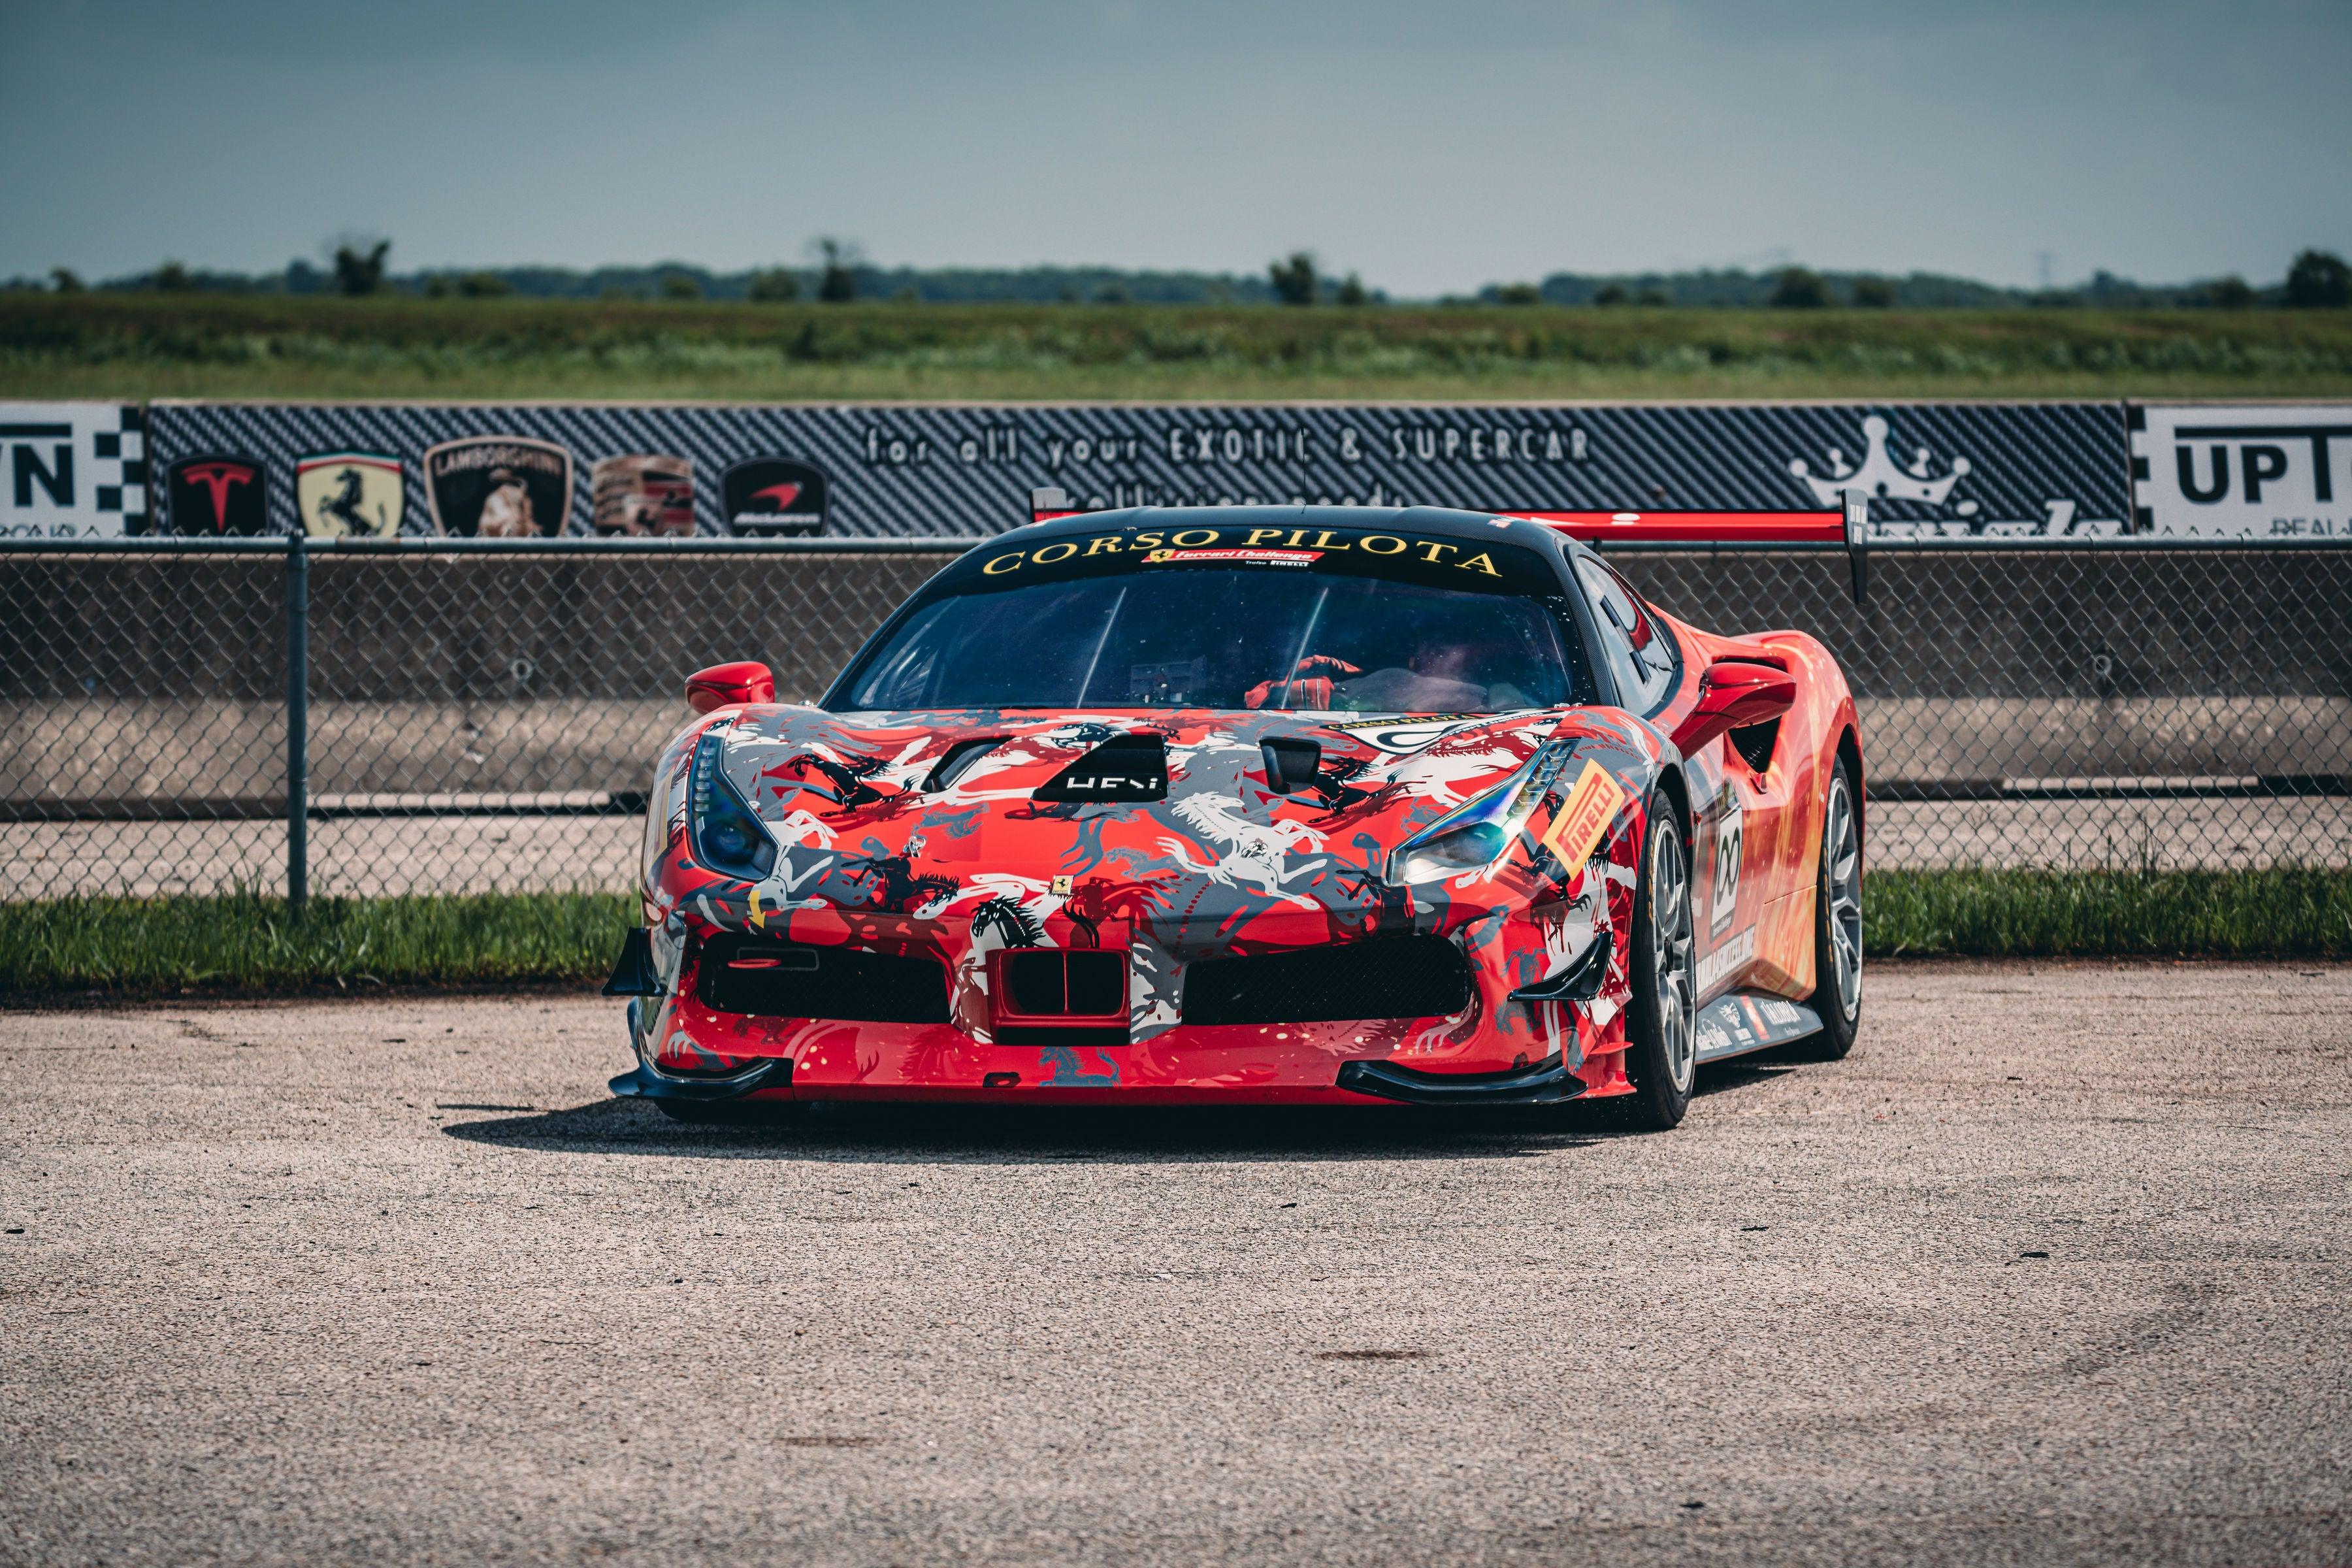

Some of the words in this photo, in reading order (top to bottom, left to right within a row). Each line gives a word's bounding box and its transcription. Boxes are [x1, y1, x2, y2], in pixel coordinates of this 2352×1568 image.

[0, 444, 74, 508] N
[868, 427, 927, 461] for
[959, 427, 1019, 461] all
[1047, 438, 1137, 469] your
[1169, 428, 1309, 461] EXOTIC
[1341, 428, 1362, 461] &
[1393, 428, 1588, 461] SUPERCAR
[2174, 426, 2352, 504] UPT
[982, 529, 1220, 575] CORSO
[1241, 529, 1503, 578] PILOTA
[1236, 549, 1313, 561] Challenge
[1556, 772, 1615, 864] PIRELLI
